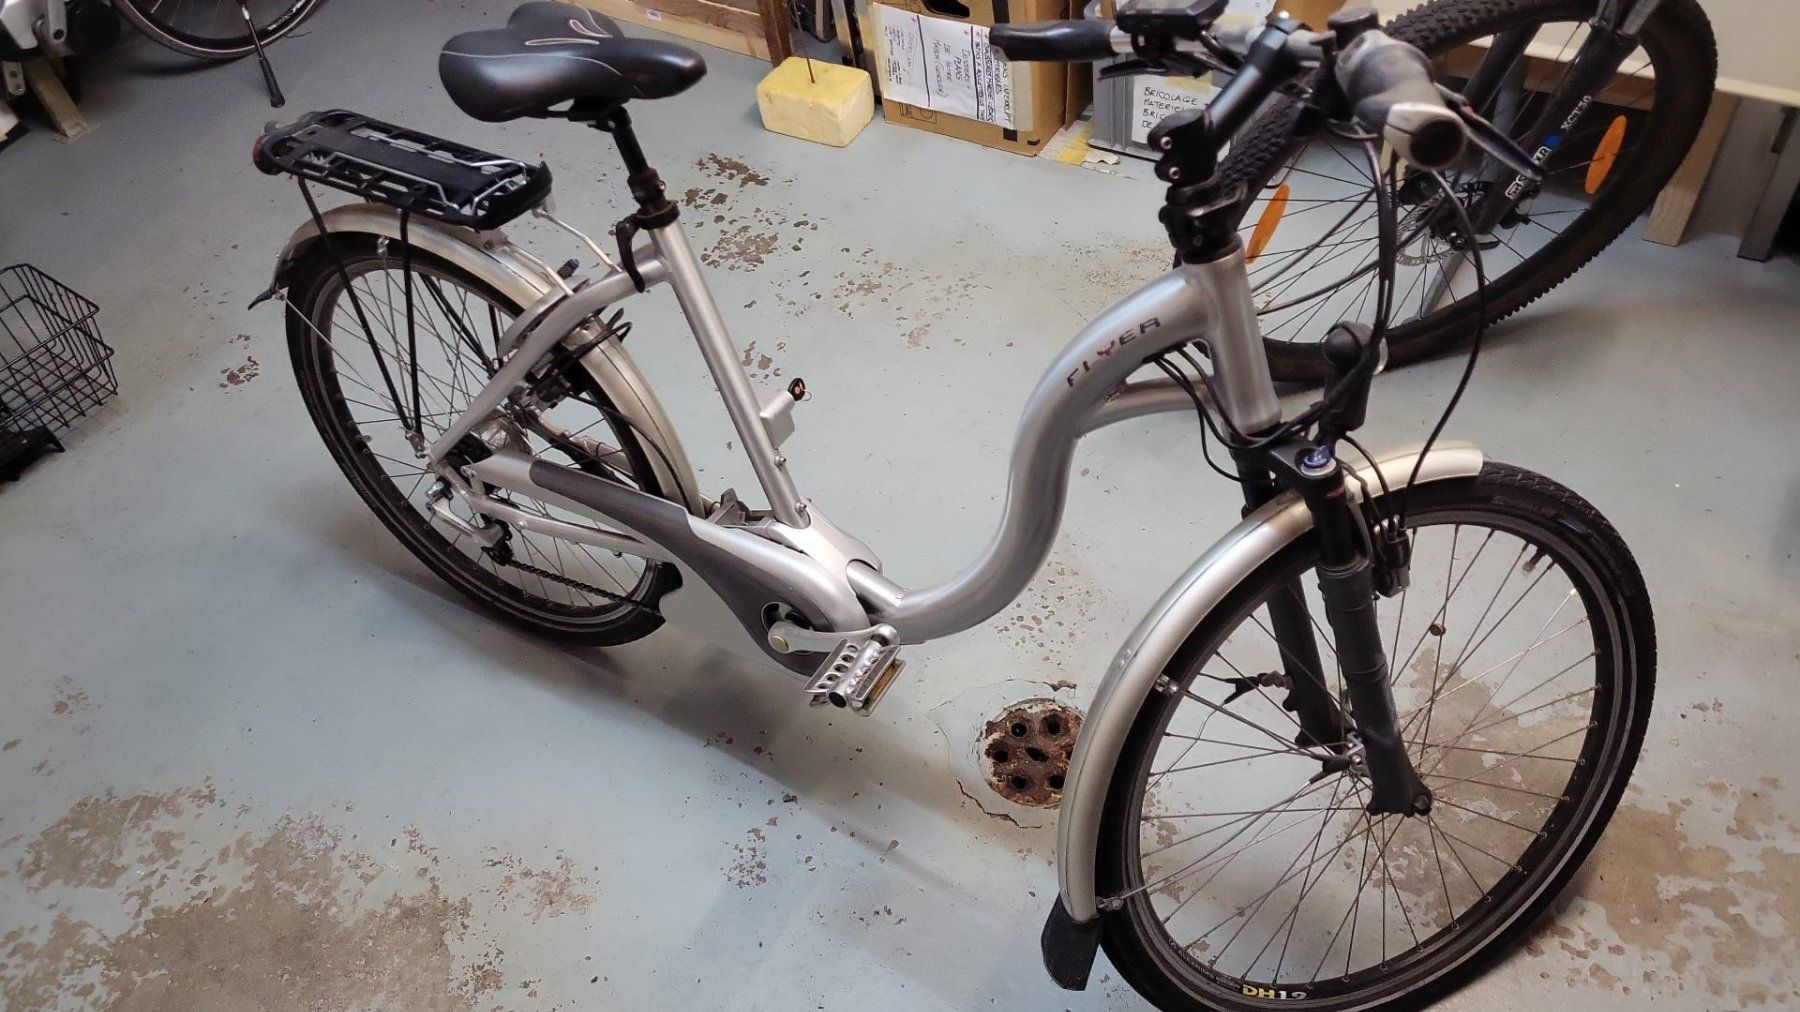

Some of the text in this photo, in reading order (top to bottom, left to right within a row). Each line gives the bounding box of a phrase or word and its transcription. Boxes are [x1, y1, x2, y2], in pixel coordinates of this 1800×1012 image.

[954, 55, 963, 81] PLANS
[1144, 86, 1198, 106] BRICOLAGE
[1560, 95, 1592, 130] XCT30
[1067, 317, 1161, 387] FLYER
